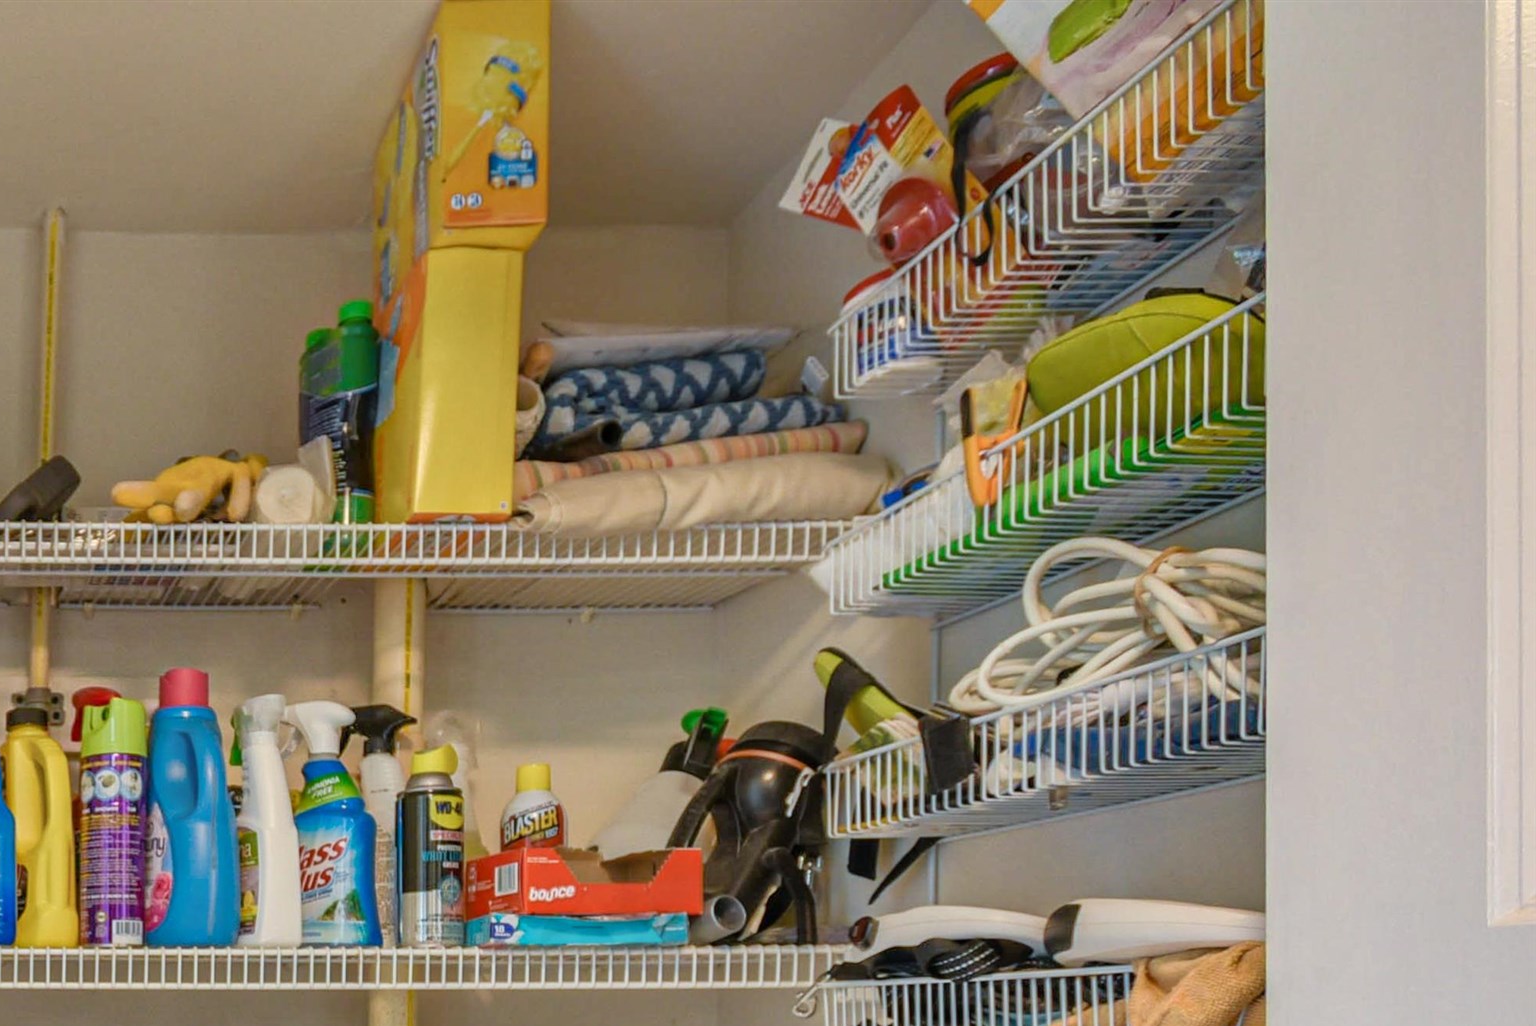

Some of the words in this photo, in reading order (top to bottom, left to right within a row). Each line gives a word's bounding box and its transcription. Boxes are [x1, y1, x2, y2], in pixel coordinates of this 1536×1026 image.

[300, 837, 348, 870] lass
[300, 866, 335, 892] lus
[529, 885, 576, 903] bounce
